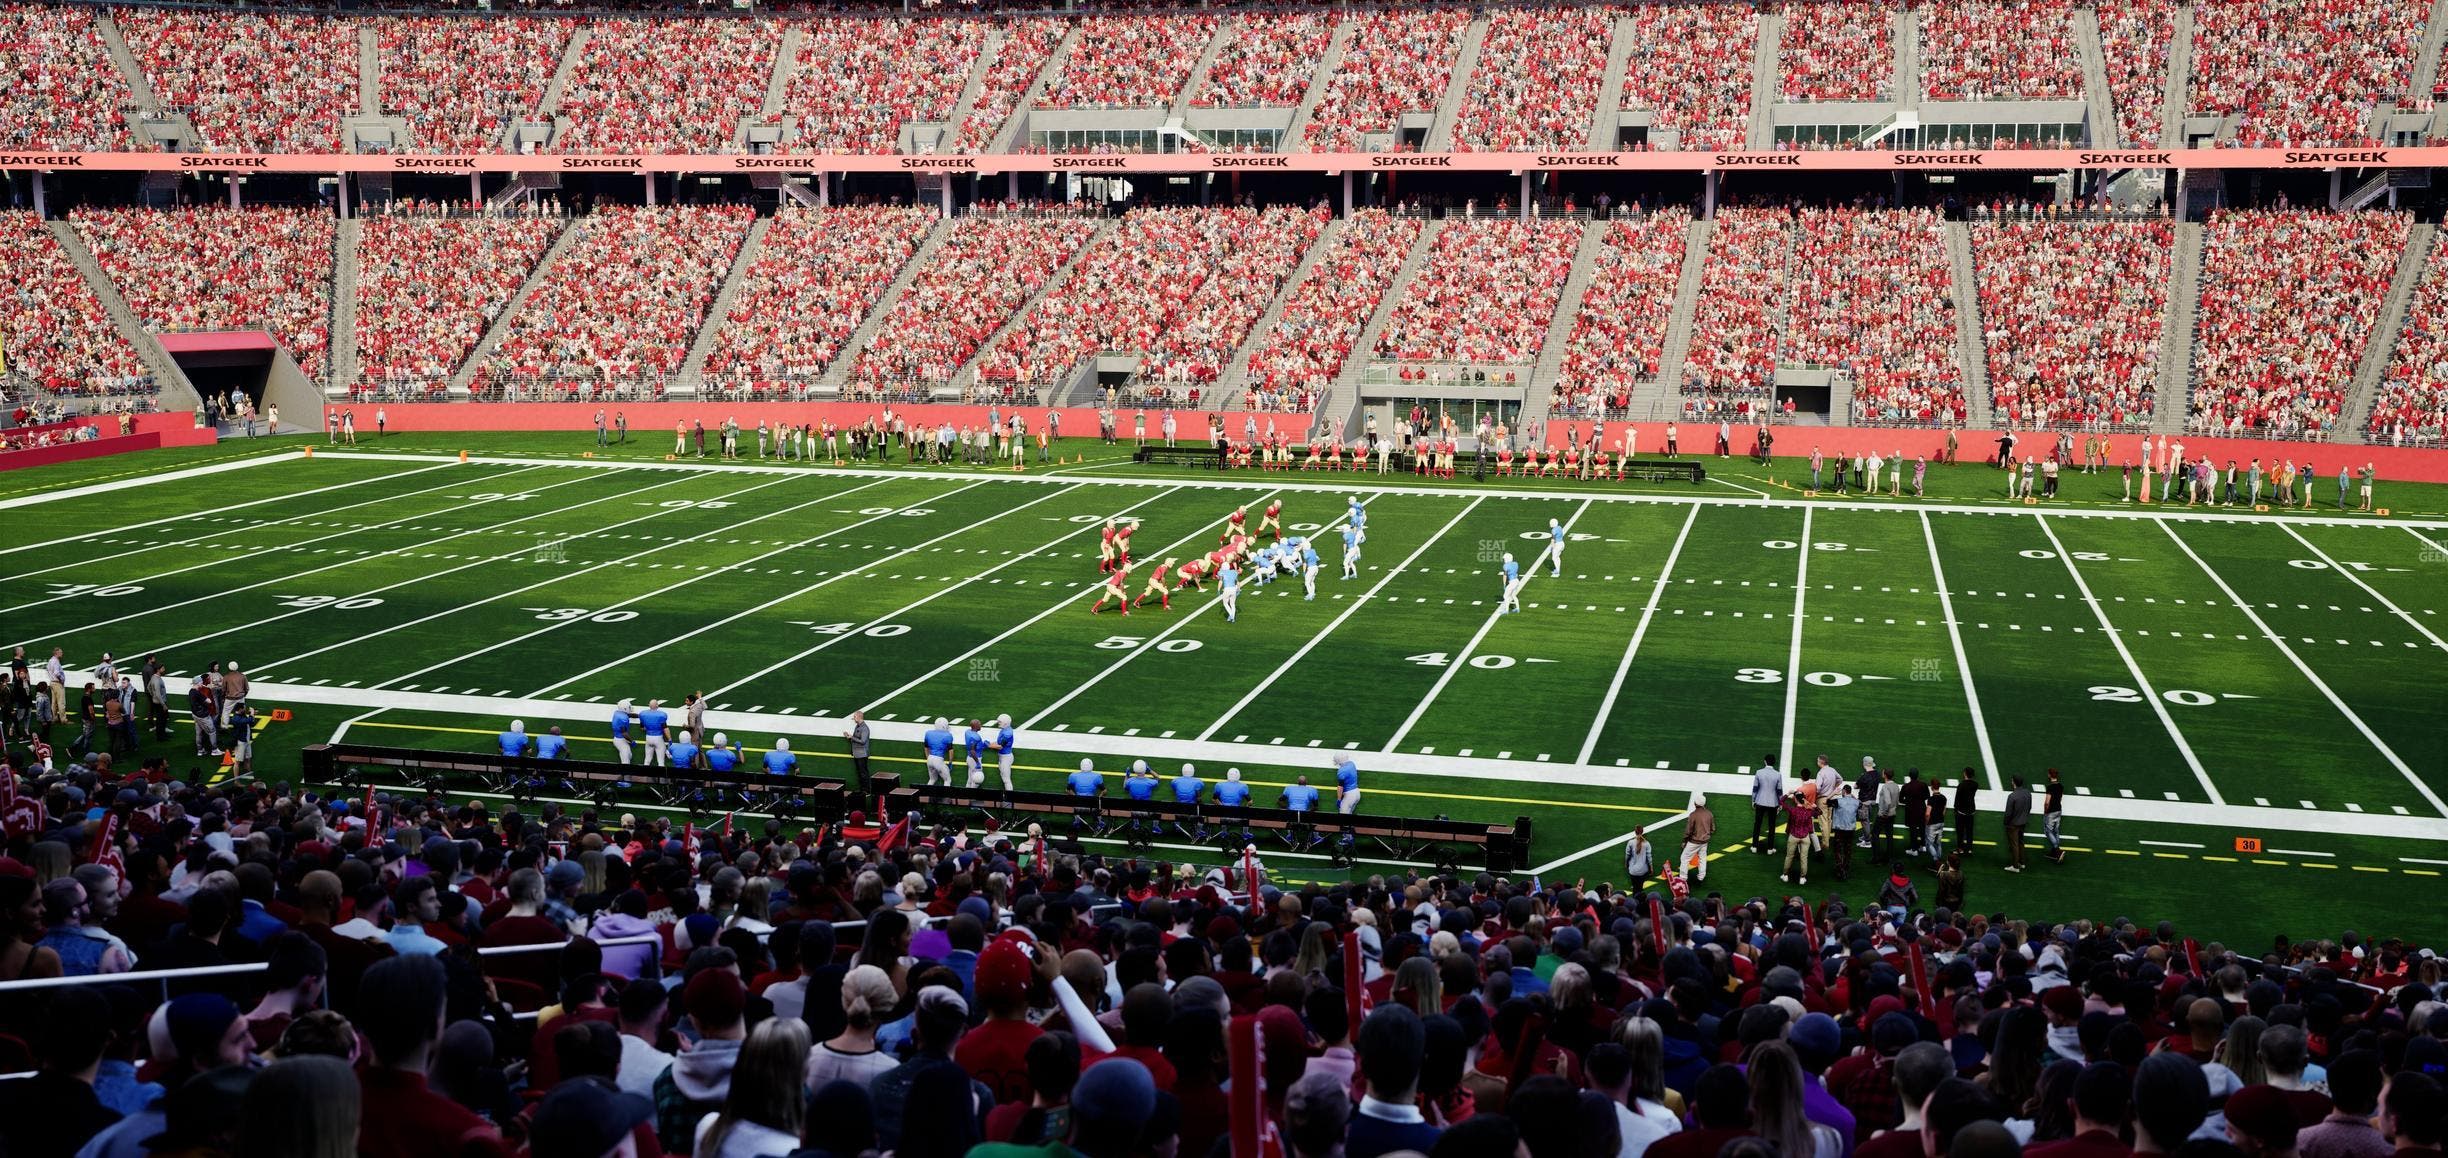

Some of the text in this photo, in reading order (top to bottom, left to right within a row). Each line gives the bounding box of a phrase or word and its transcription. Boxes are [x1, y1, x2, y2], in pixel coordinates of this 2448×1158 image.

[181, 156, 268, 167] SEATGEEK
[1212, 158, 1289, 167] SEATGEEK
[1372, 157, 1451, 167] SEATGEEK
[1537, 156, 1620, 166] SEATGEEK
[1716, 156, 1801, 166] SEATGEEK
[1894, 155, 1983, 165] SEATGEEK
[2079, 154, 2172, 165] SEATGEEK
[2285, 152, 2388, 163] SEATGEEK
[395, 158, 476, 168] SEATGEEK
[562, 159, 643, 168] SEATGEEK
[735, 159, 815, 168] SEATGEEK
[901, 158, 975, 168] SEATGEEK
[1052, 158, 1127, 168] SEATGEEK
[535, 608, 639, 622] 30
[809, 622, 912, 637] 40
[1094, 636, 1204, 652] 50
[1404, 652, 1517, 669] 40
[1734, 668, 1853, 687] 30
[2087, 686, 2217, 706] 20
[2242, 840, 2256, 850] 30
